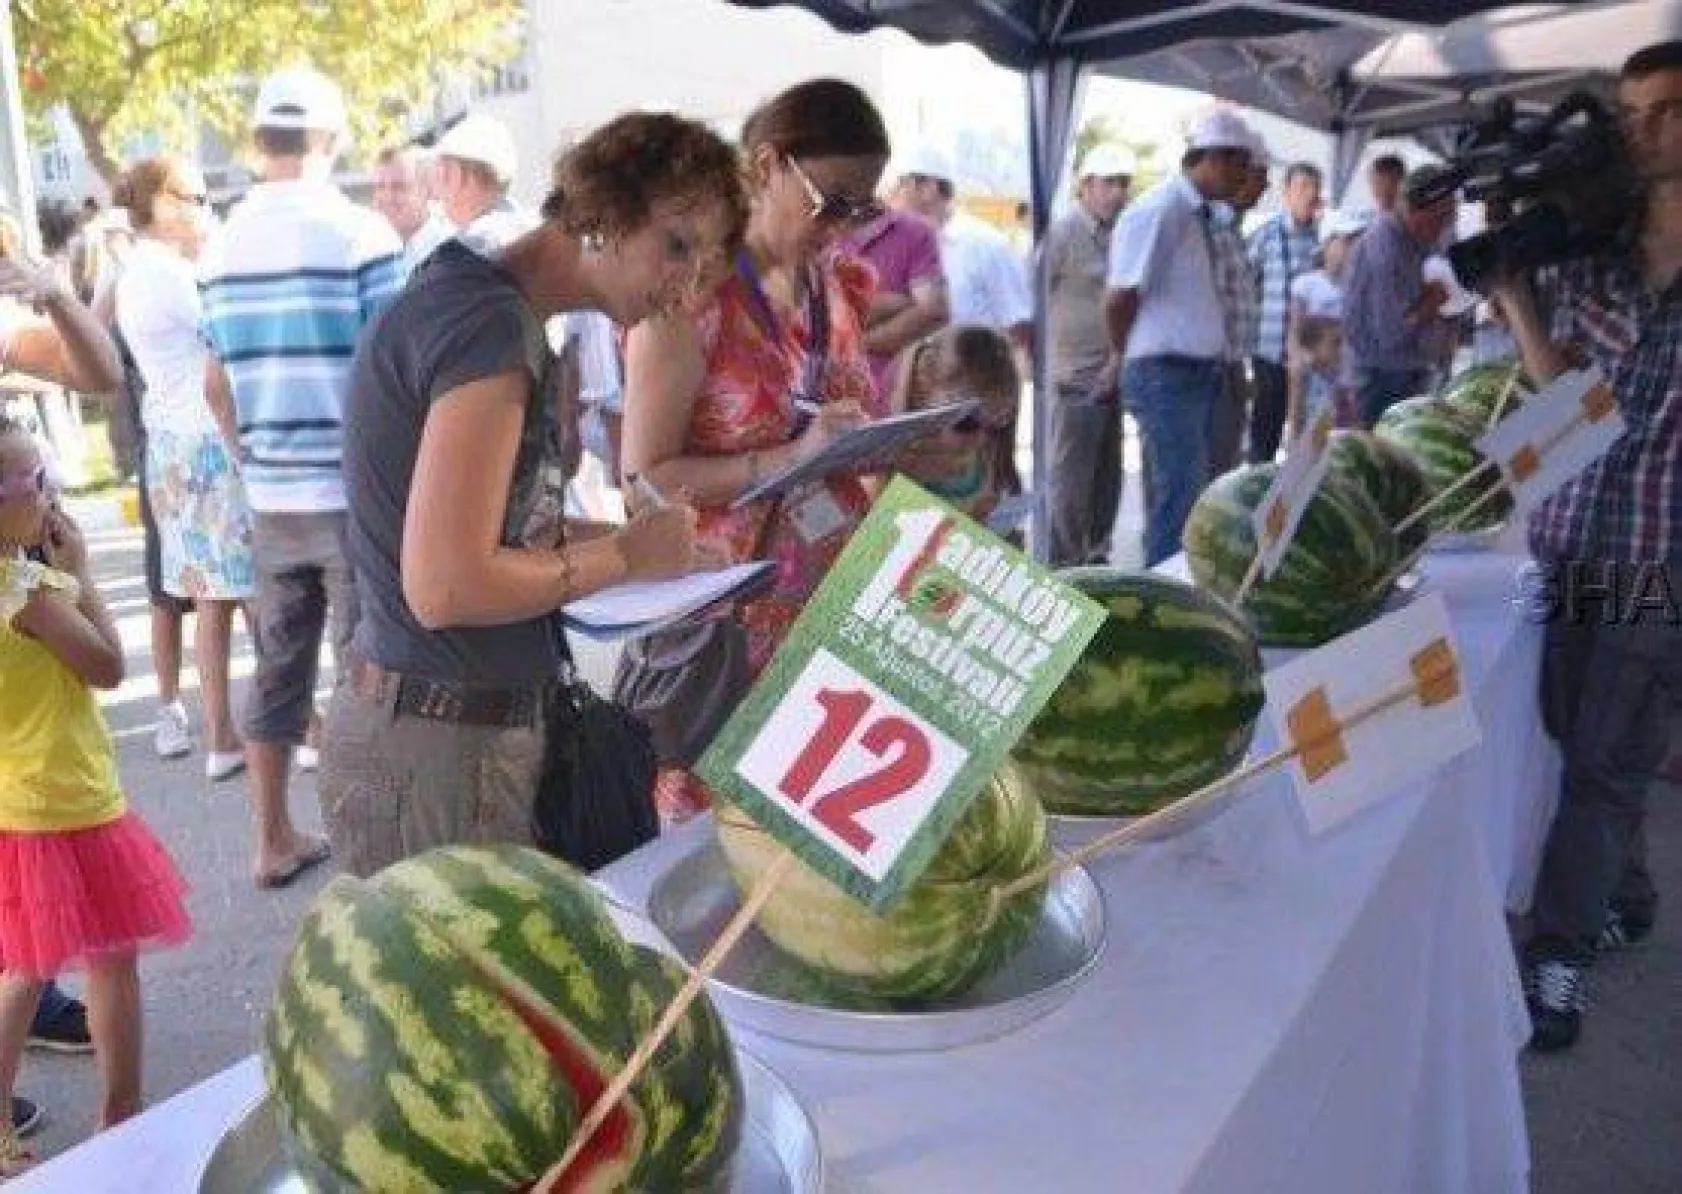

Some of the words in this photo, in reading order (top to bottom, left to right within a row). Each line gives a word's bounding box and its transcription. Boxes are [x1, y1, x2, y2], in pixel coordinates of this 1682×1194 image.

[835, 616, 868, 647] 25
[941, 689, 1003, 742] 2012
[871, 594, 1030, 720] Festivali
[776, 688, 930, 856] 12
